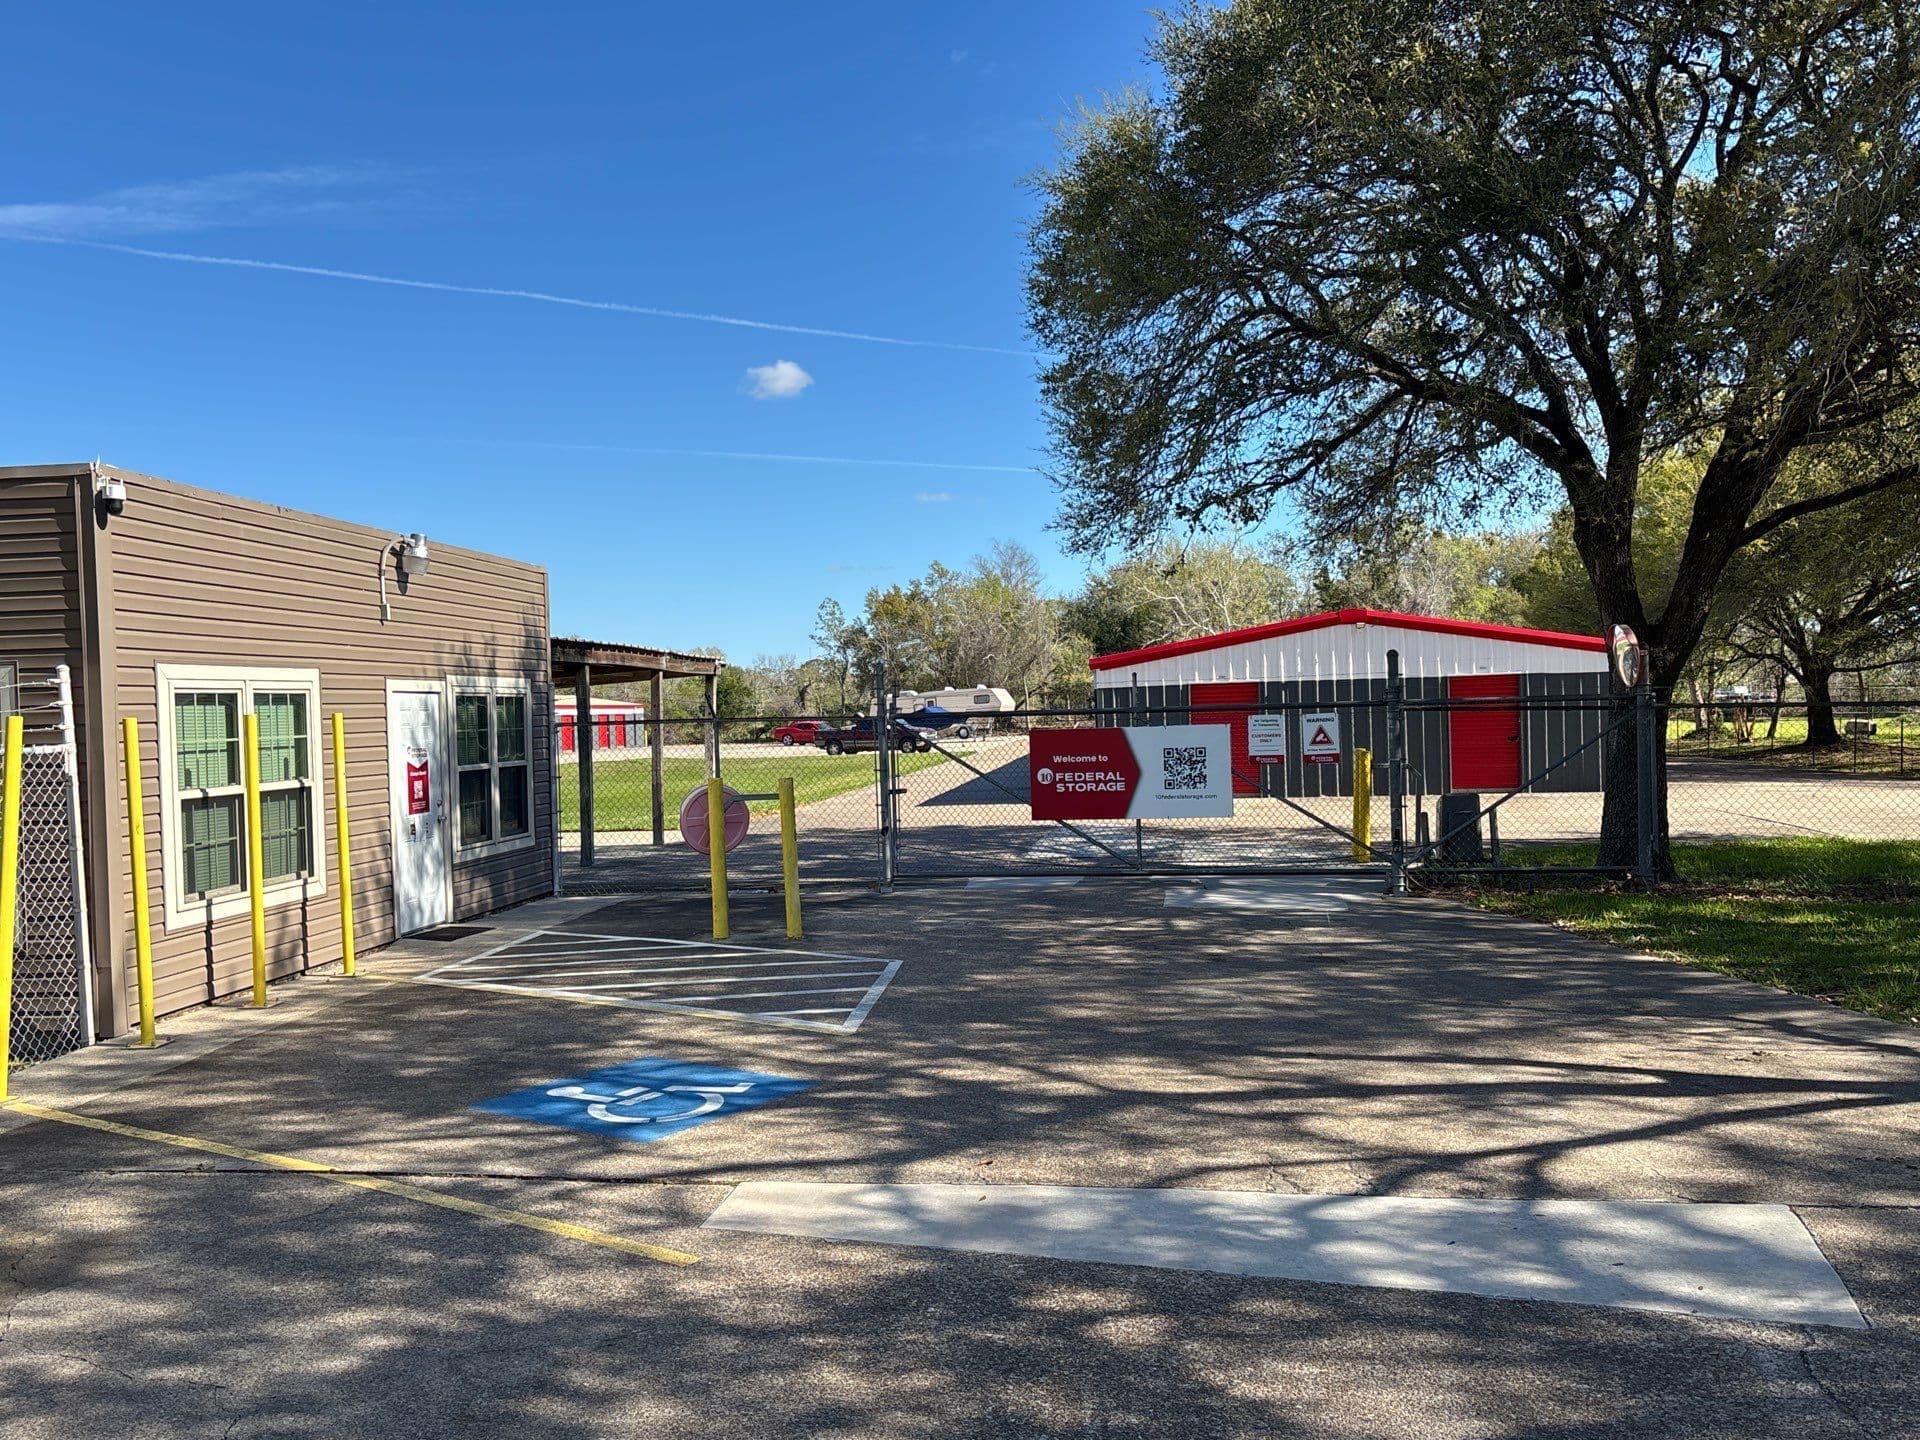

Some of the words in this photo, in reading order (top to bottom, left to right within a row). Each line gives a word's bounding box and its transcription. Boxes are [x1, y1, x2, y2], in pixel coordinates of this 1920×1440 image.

[1053, 755, 1097, 763] Welcome
[1098, 754, 1109, 762] to
[1055, 771, 1125, 782] FEDERAL
[1056, 782, 1126, 792] STORAGE
